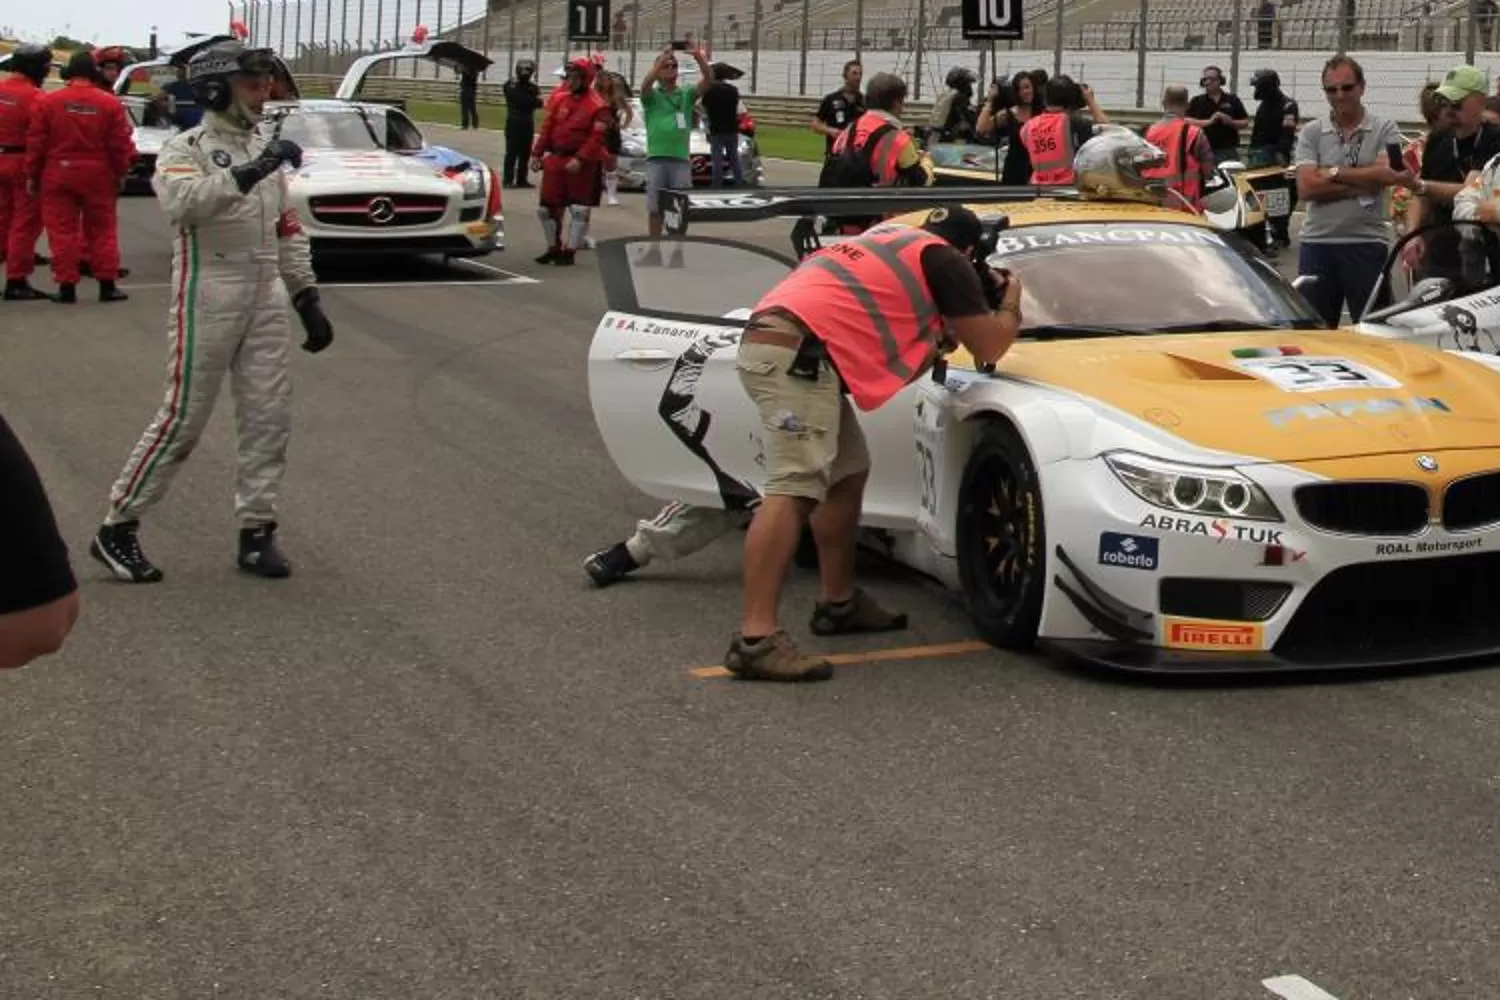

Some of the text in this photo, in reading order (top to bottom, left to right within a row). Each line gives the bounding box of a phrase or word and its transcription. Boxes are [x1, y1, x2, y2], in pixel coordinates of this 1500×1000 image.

[575, 5, 603, 34] 11
[996, 229, 1228, 254] BLANCPAIN
[643, 323, 699, 339] Zanardi
[1268, 363, 1368, 385] 33
[1375, 537, 1483, 556] ROAL Motorsport
[1102, 551, 1153, 568] roberlo
[1171, 623, 1255, 646] PIRELLI
